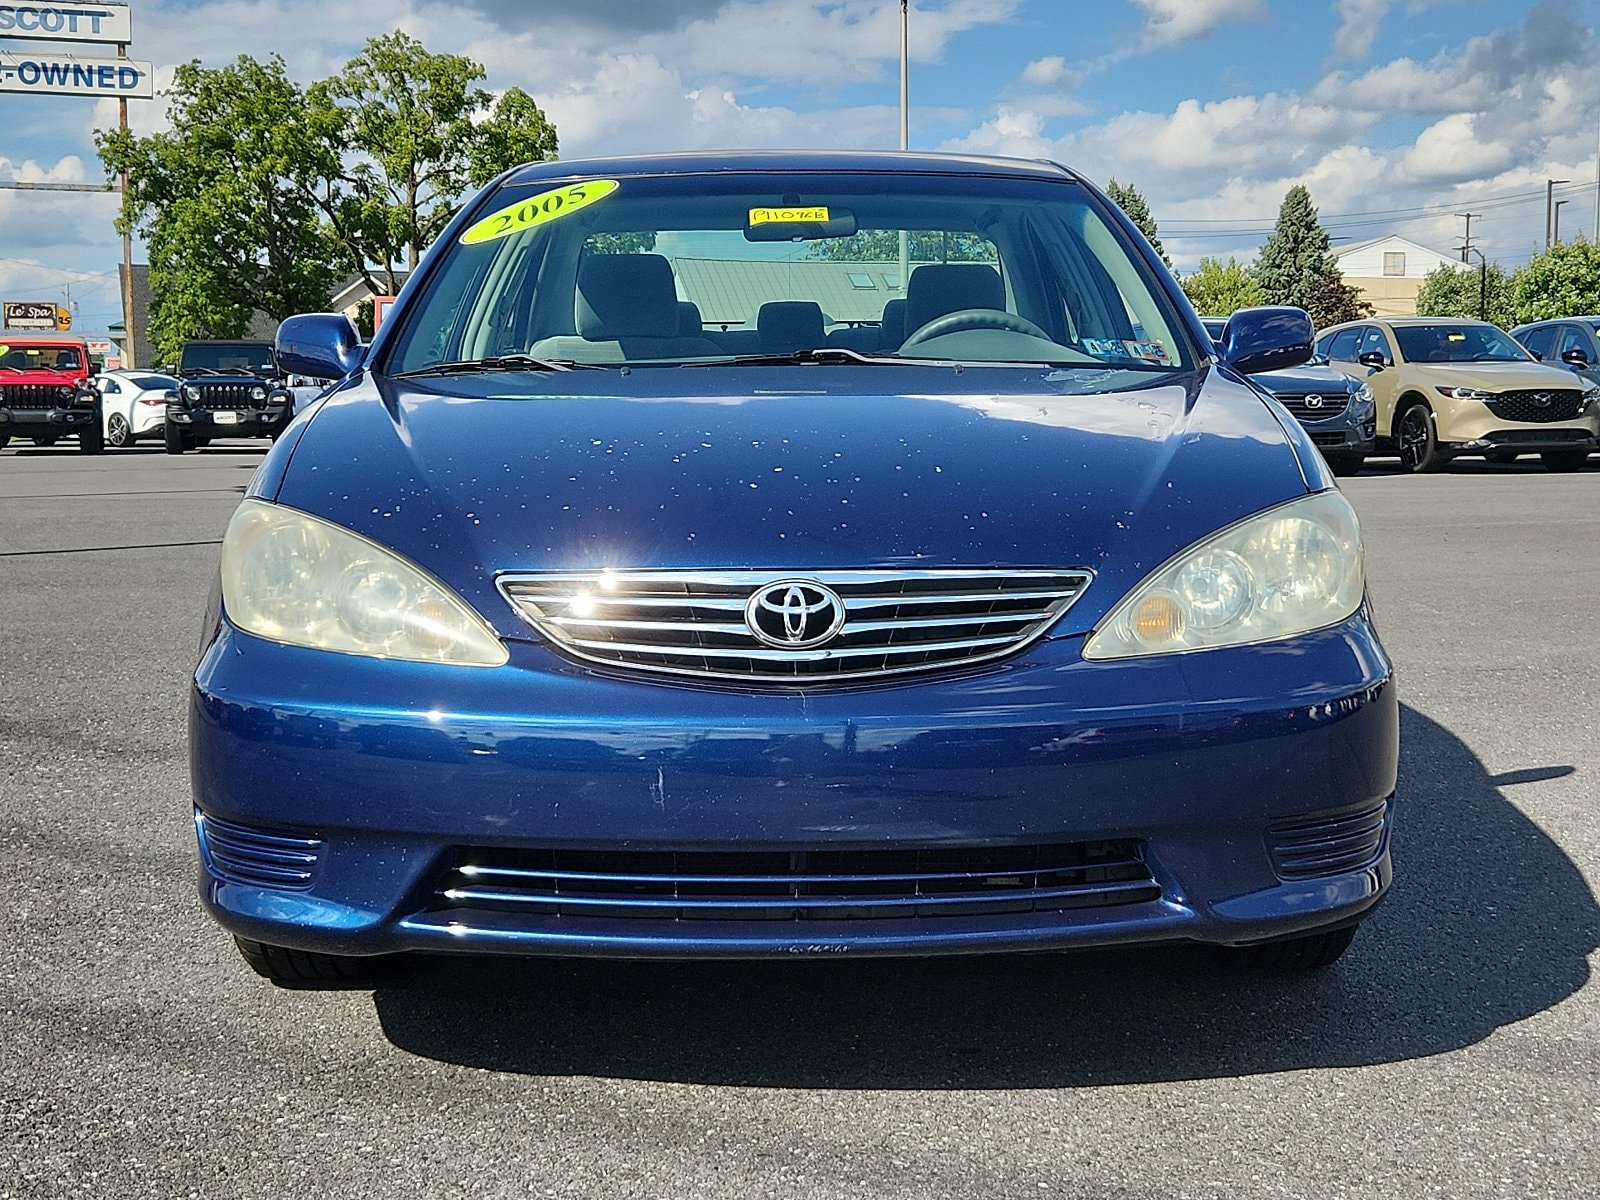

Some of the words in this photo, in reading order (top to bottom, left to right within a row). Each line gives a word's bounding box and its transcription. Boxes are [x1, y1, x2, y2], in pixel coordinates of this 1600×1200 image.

[0, 6, 107, 34] SCOTT
[0, 61, 139, 89] -OWNED
[493, 186, 587, 235] 2005
[27, 306, 52, 320] Spa
